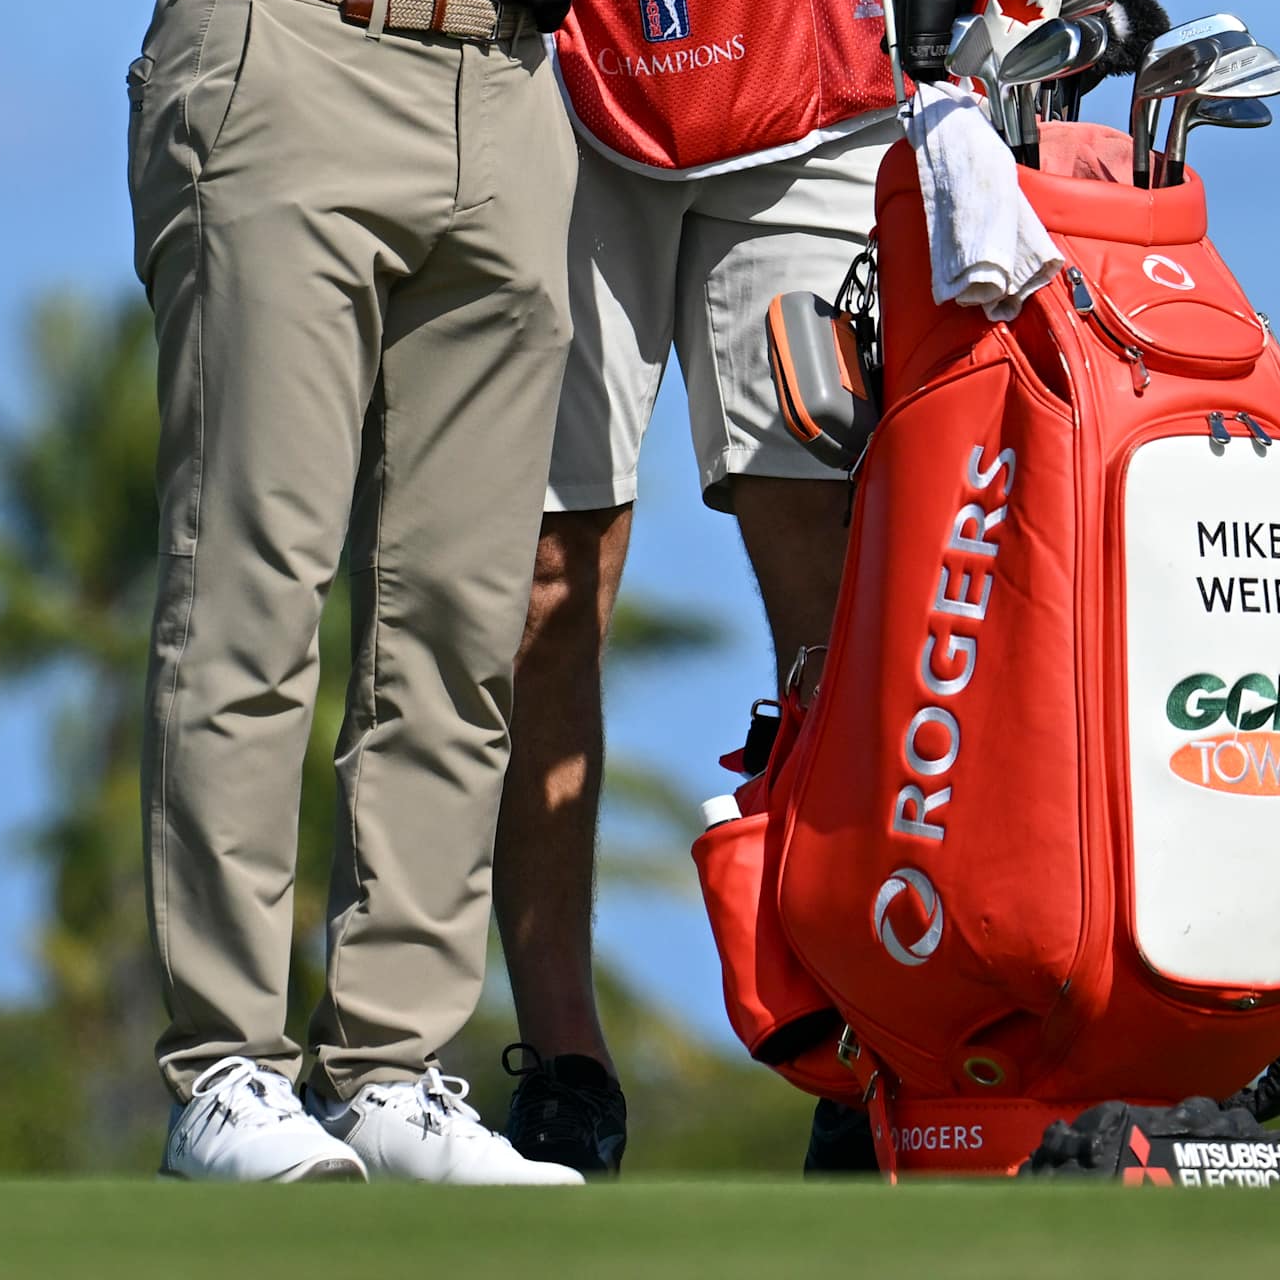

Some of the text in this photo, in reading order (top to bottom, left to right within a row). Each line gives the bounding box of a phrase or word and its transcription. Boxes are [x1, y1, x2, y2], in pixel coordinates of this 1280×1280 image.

[597, 33, 746, 77] CHAMPIONS
[893, 445, 1016, 840] ROGERS
[902, 1125, 983, 1151] ROGERS
